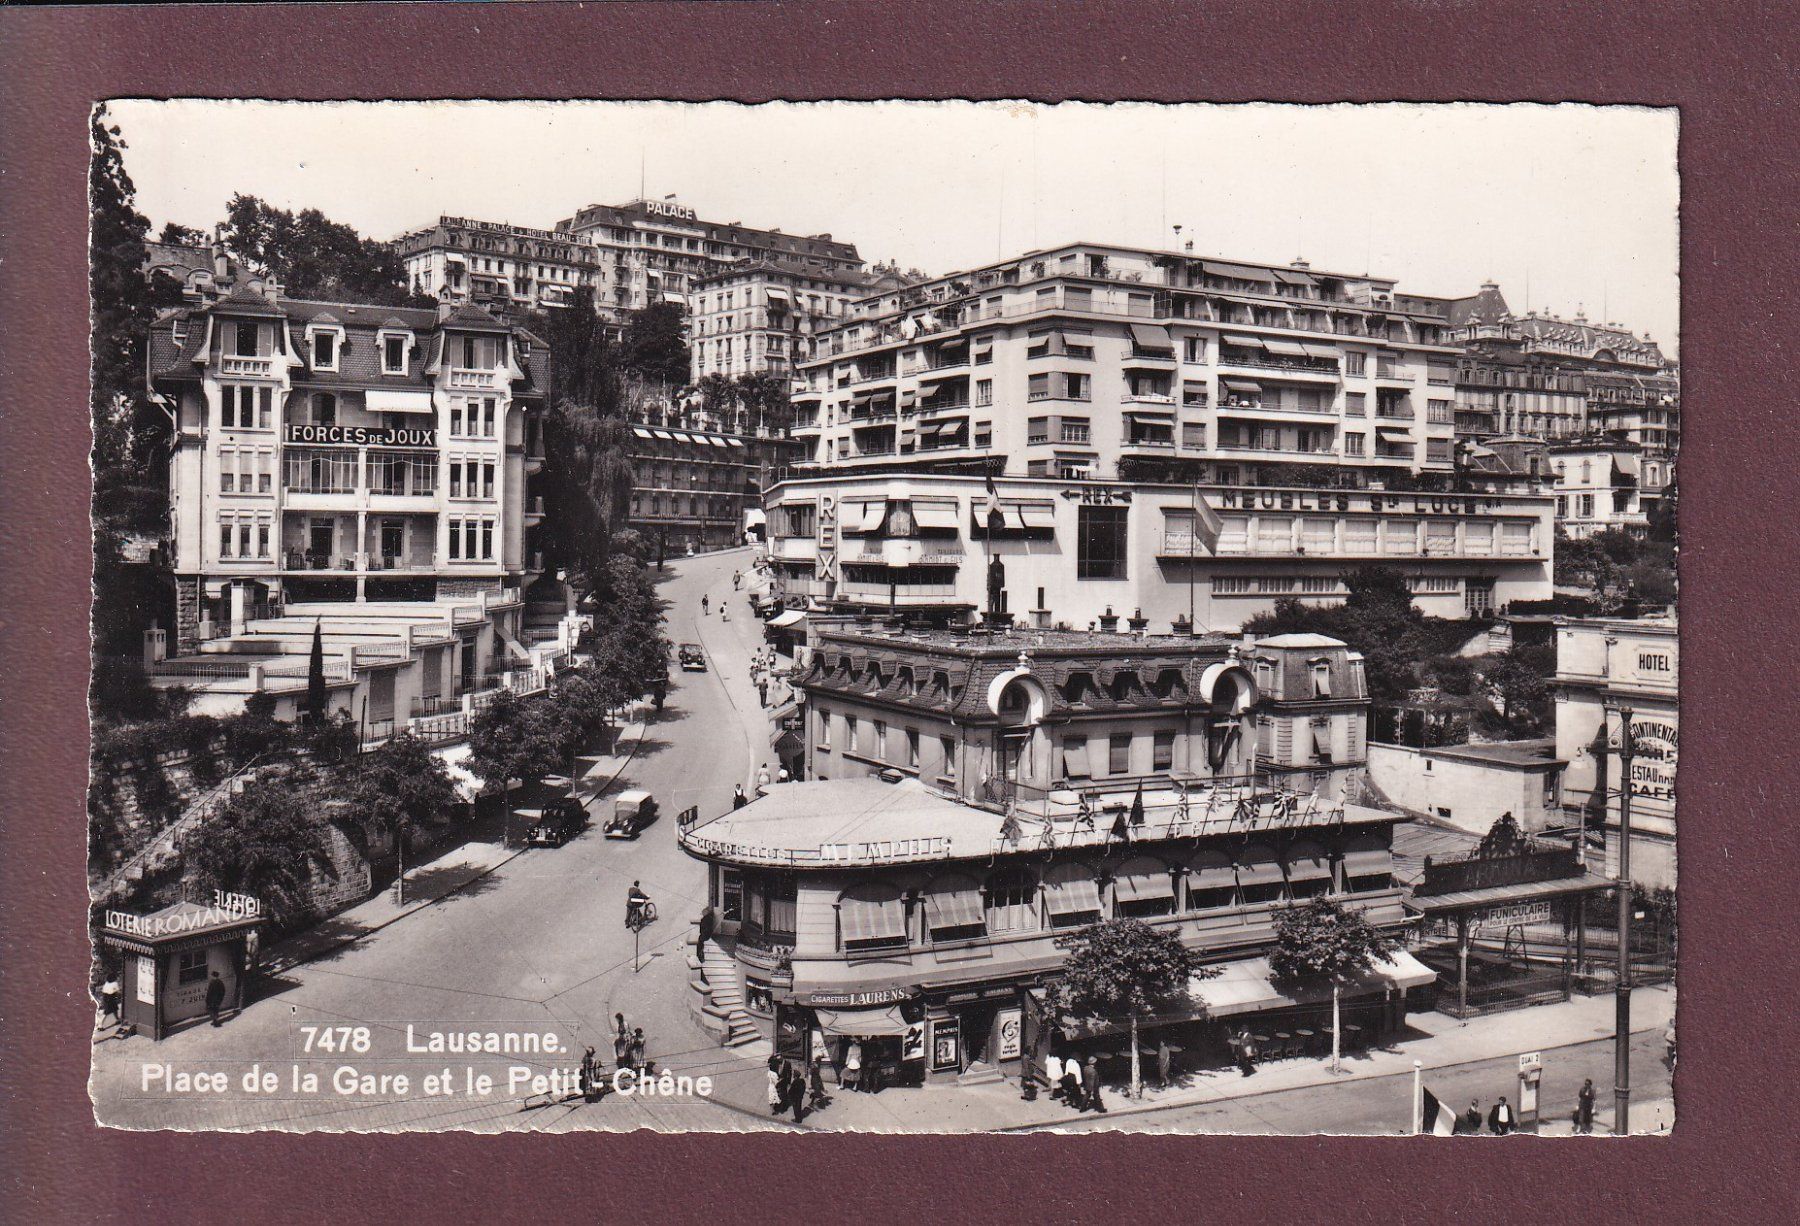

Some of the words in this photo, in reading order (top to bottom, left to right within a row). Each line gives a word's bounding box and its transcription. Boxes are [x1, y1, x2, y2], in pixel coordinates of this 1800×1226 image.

[646, 201, 693, 220] PALACE
[526, 227, 549, 239] HOTEL
[292, 425, 367, 443] FORCES
[369, 434, 383, 444] DE
[384, 429, 433, 446] JOUX
[1082, 486, 1113, 505] REX
[1222, 491, 1349, 511] MEUBLES
[1413, 496, 1476, 514] LUCE
[819, 493, 836, 581] REX
[1638, 653, 1671, 672] HOTEL
[105, 909, 152, 937] LOTERIE
[154, 902, 256, 936] ROMANDE
[1490, 902, 1549, 920] FUNICULAIRE
[811, 994, 849, 1004] CIGARETTES
[849, 988, 905, 1006] LAURENS
